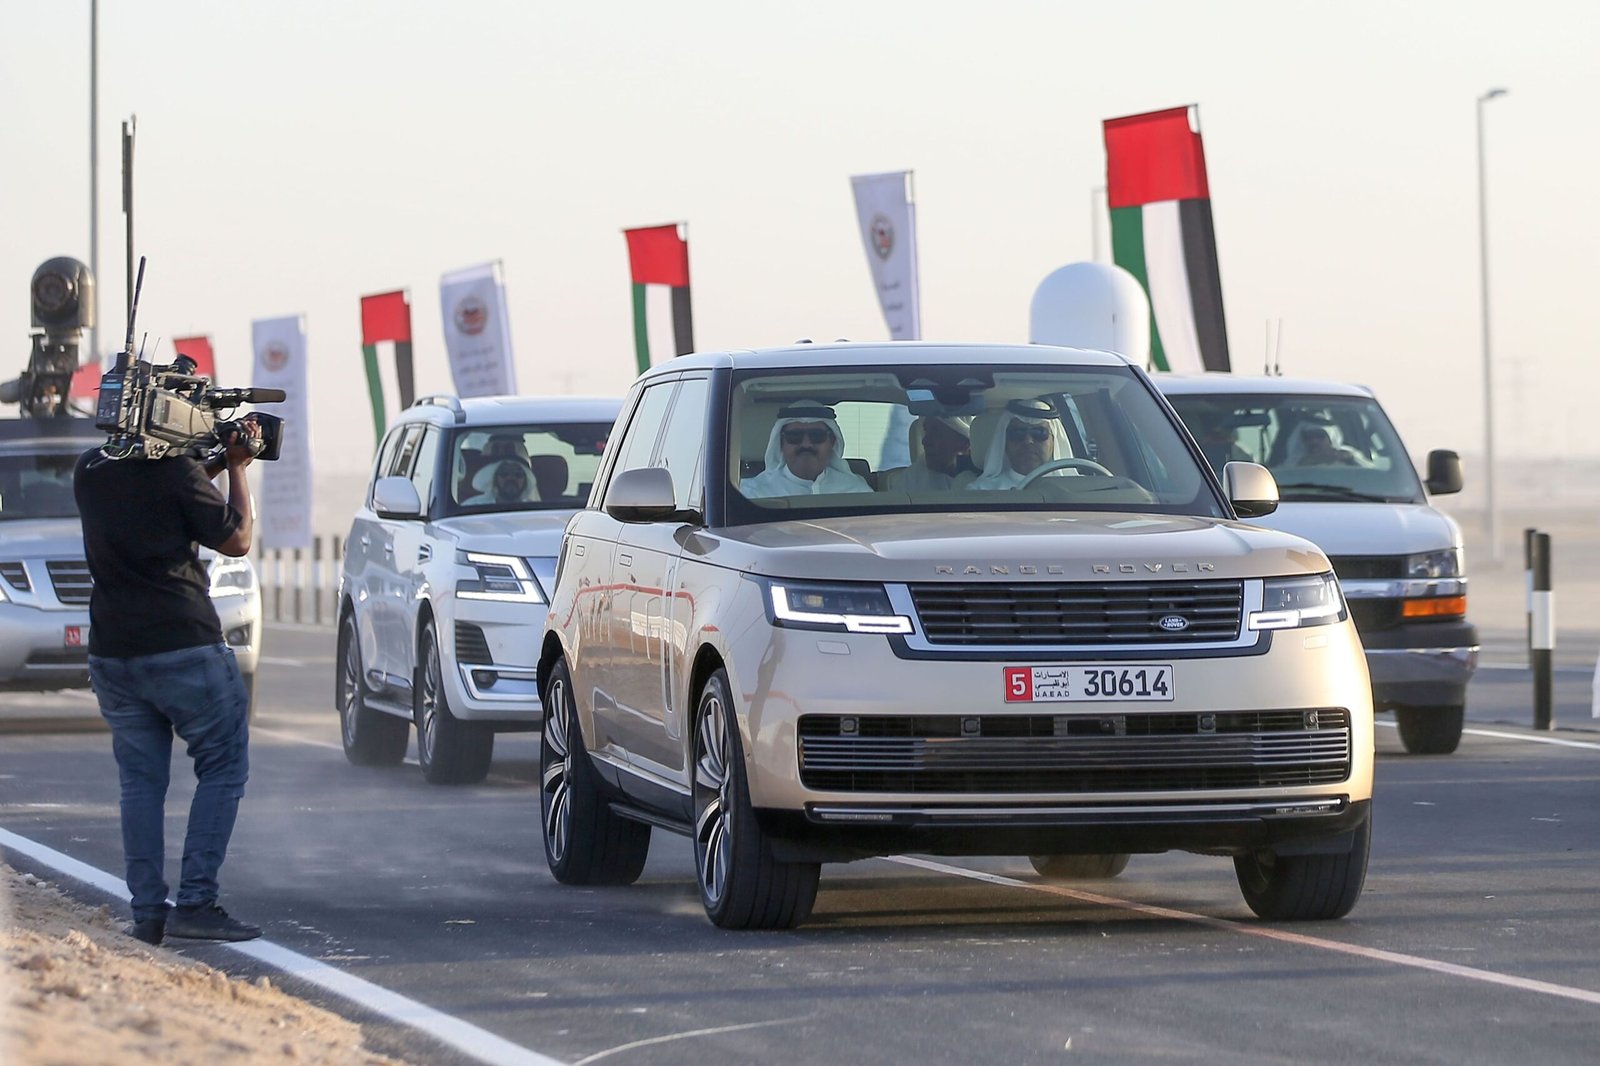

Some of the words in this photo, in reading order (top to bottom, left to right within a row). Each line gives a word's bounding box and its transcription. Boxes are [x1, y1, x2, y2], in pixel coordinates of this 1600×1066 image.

[934, 564, 1065, 575] RANGE
[1091, 562, 1216, 575] ROVER
[1012, 673, 1026, 695] 5
[1084, 670, 1168, 696] 30614
